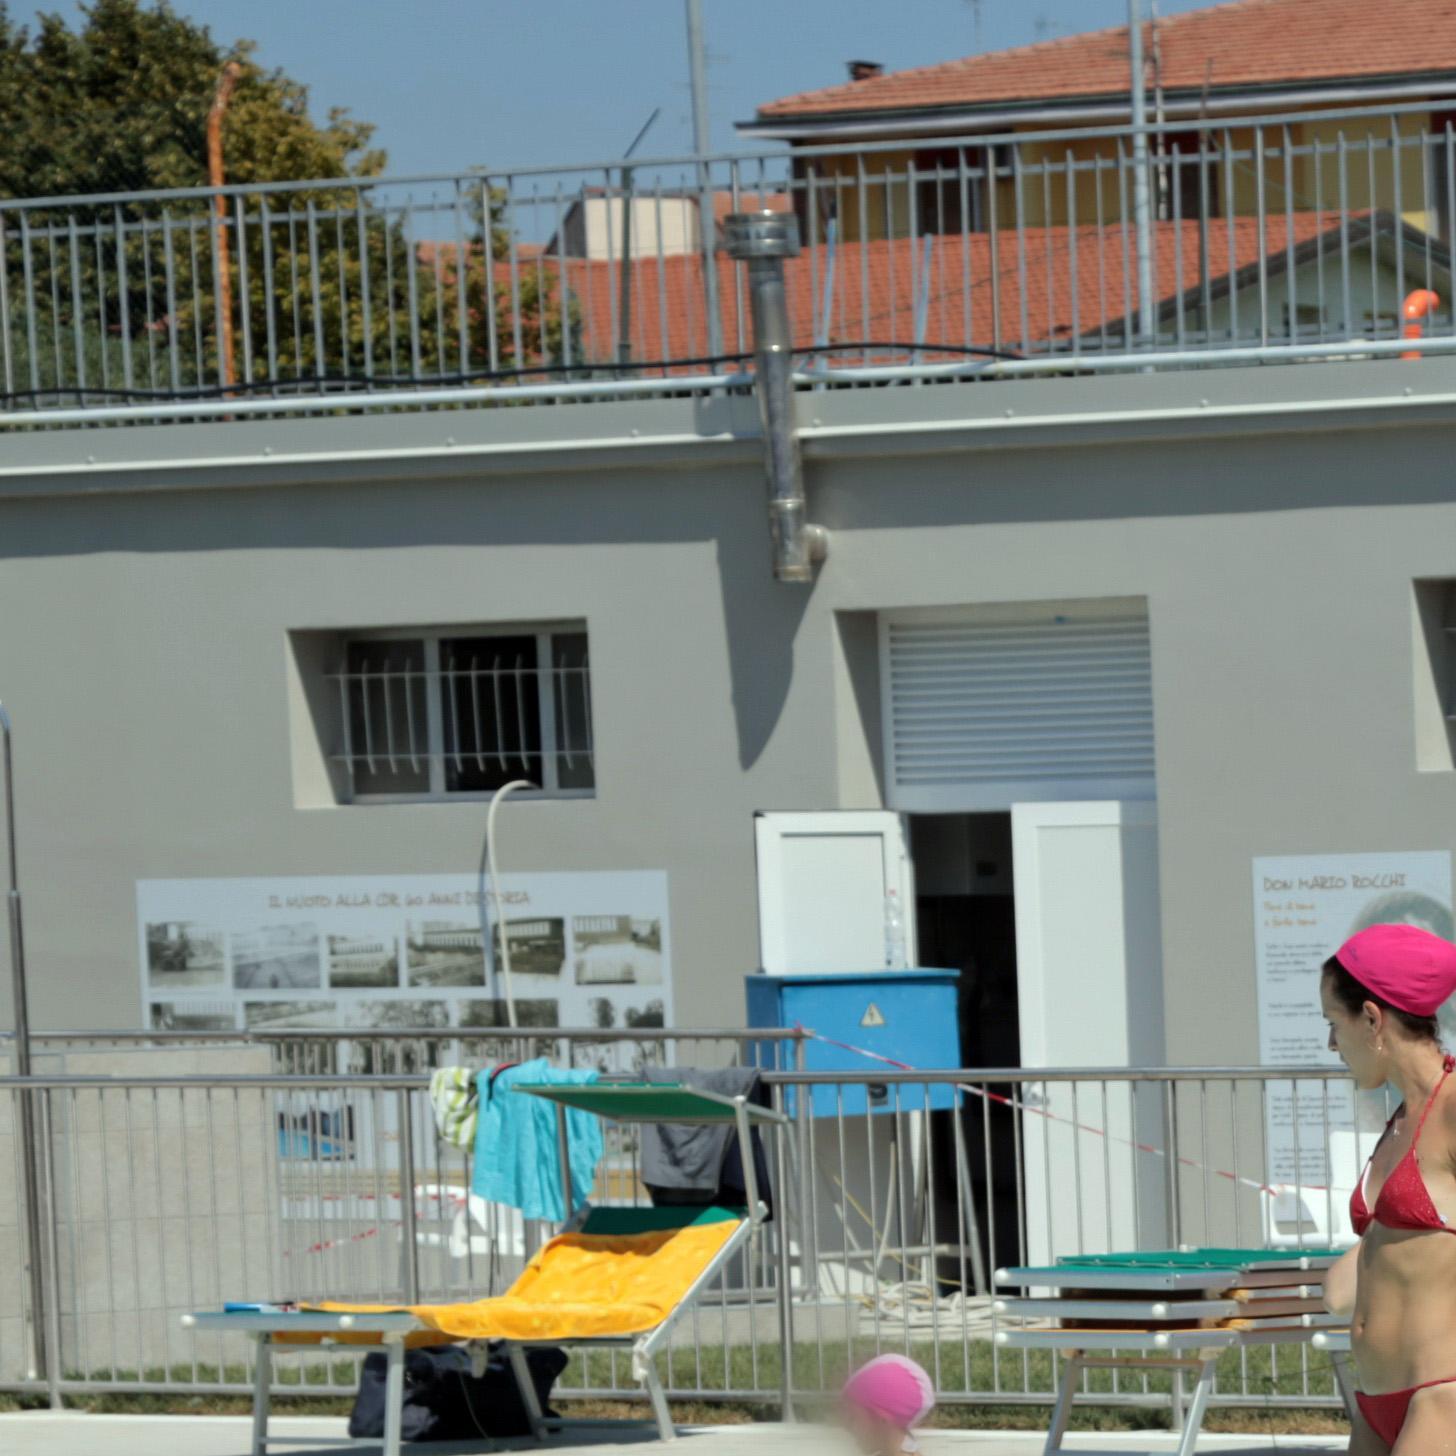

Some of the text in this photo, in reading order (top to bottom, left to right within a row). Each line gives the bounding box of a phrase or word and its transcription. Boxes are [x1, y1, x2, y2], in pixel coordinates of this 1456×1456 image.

[1263, 876, 1292, 891] DON
[1298, 874, 1346, 890] MARIO
[336, 893, 370, 907] ALLA
